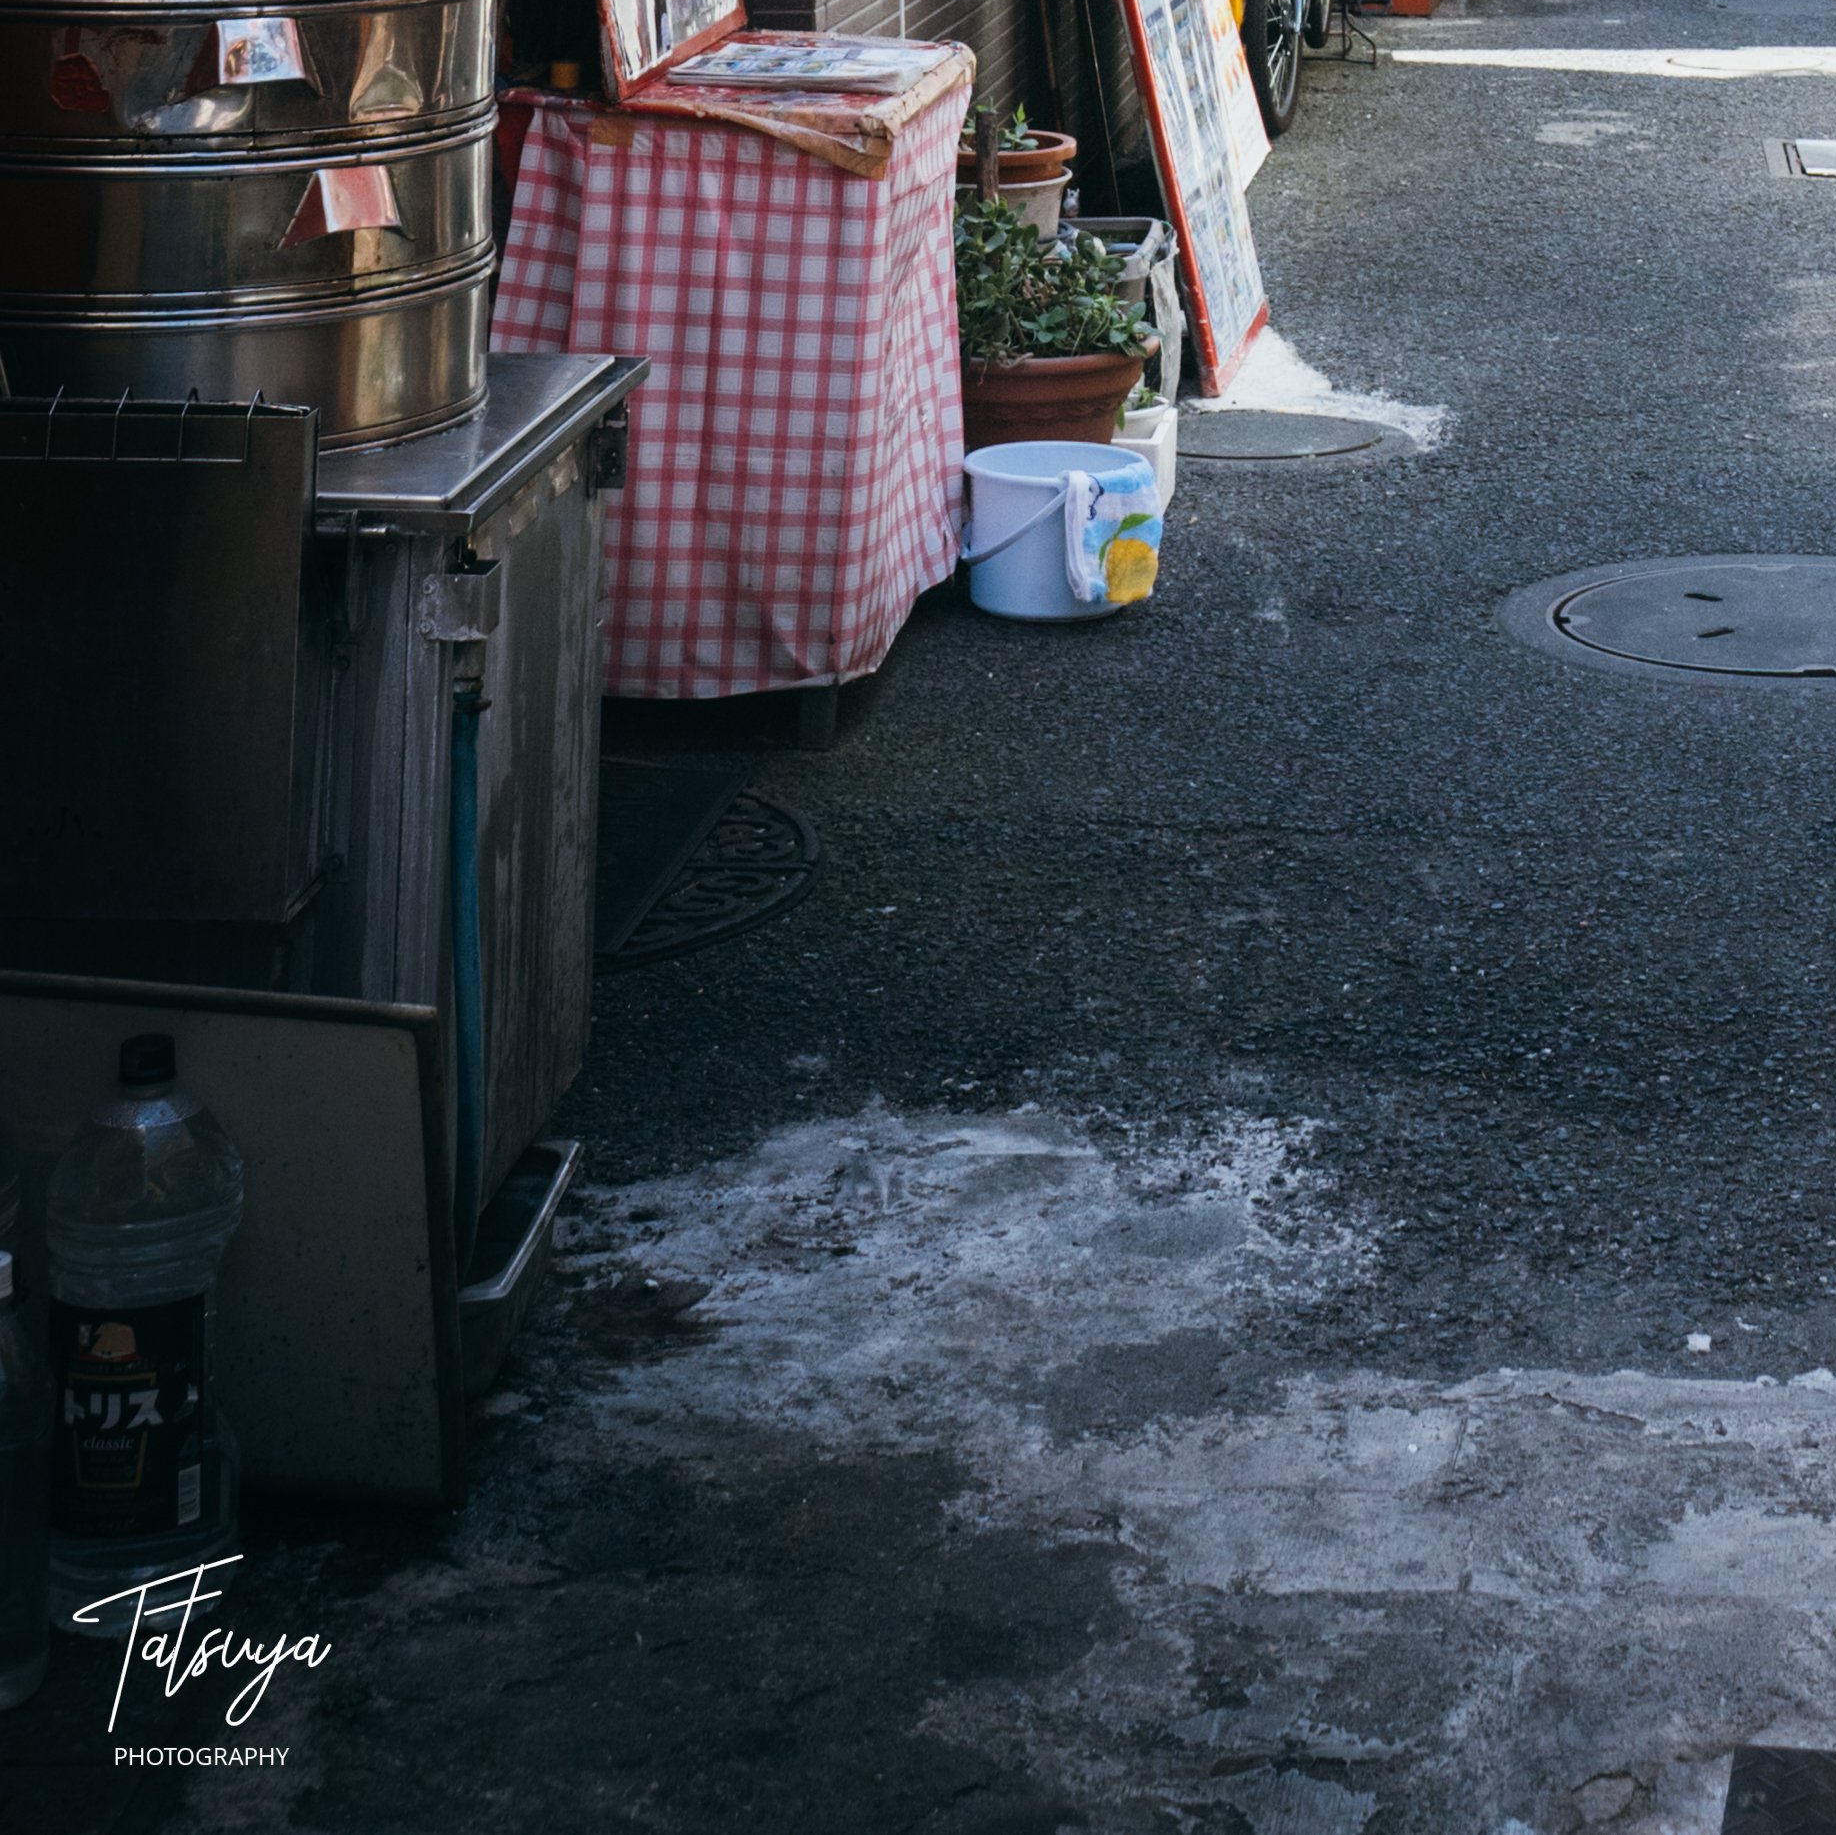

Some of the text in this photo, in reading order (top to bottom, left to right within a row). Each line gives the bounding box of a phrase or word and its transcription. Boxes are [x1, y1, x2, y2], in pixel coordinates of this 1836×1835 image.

[64, 1388, 164, 1430] トリス
[83, 1434, 135, 1451] classic
